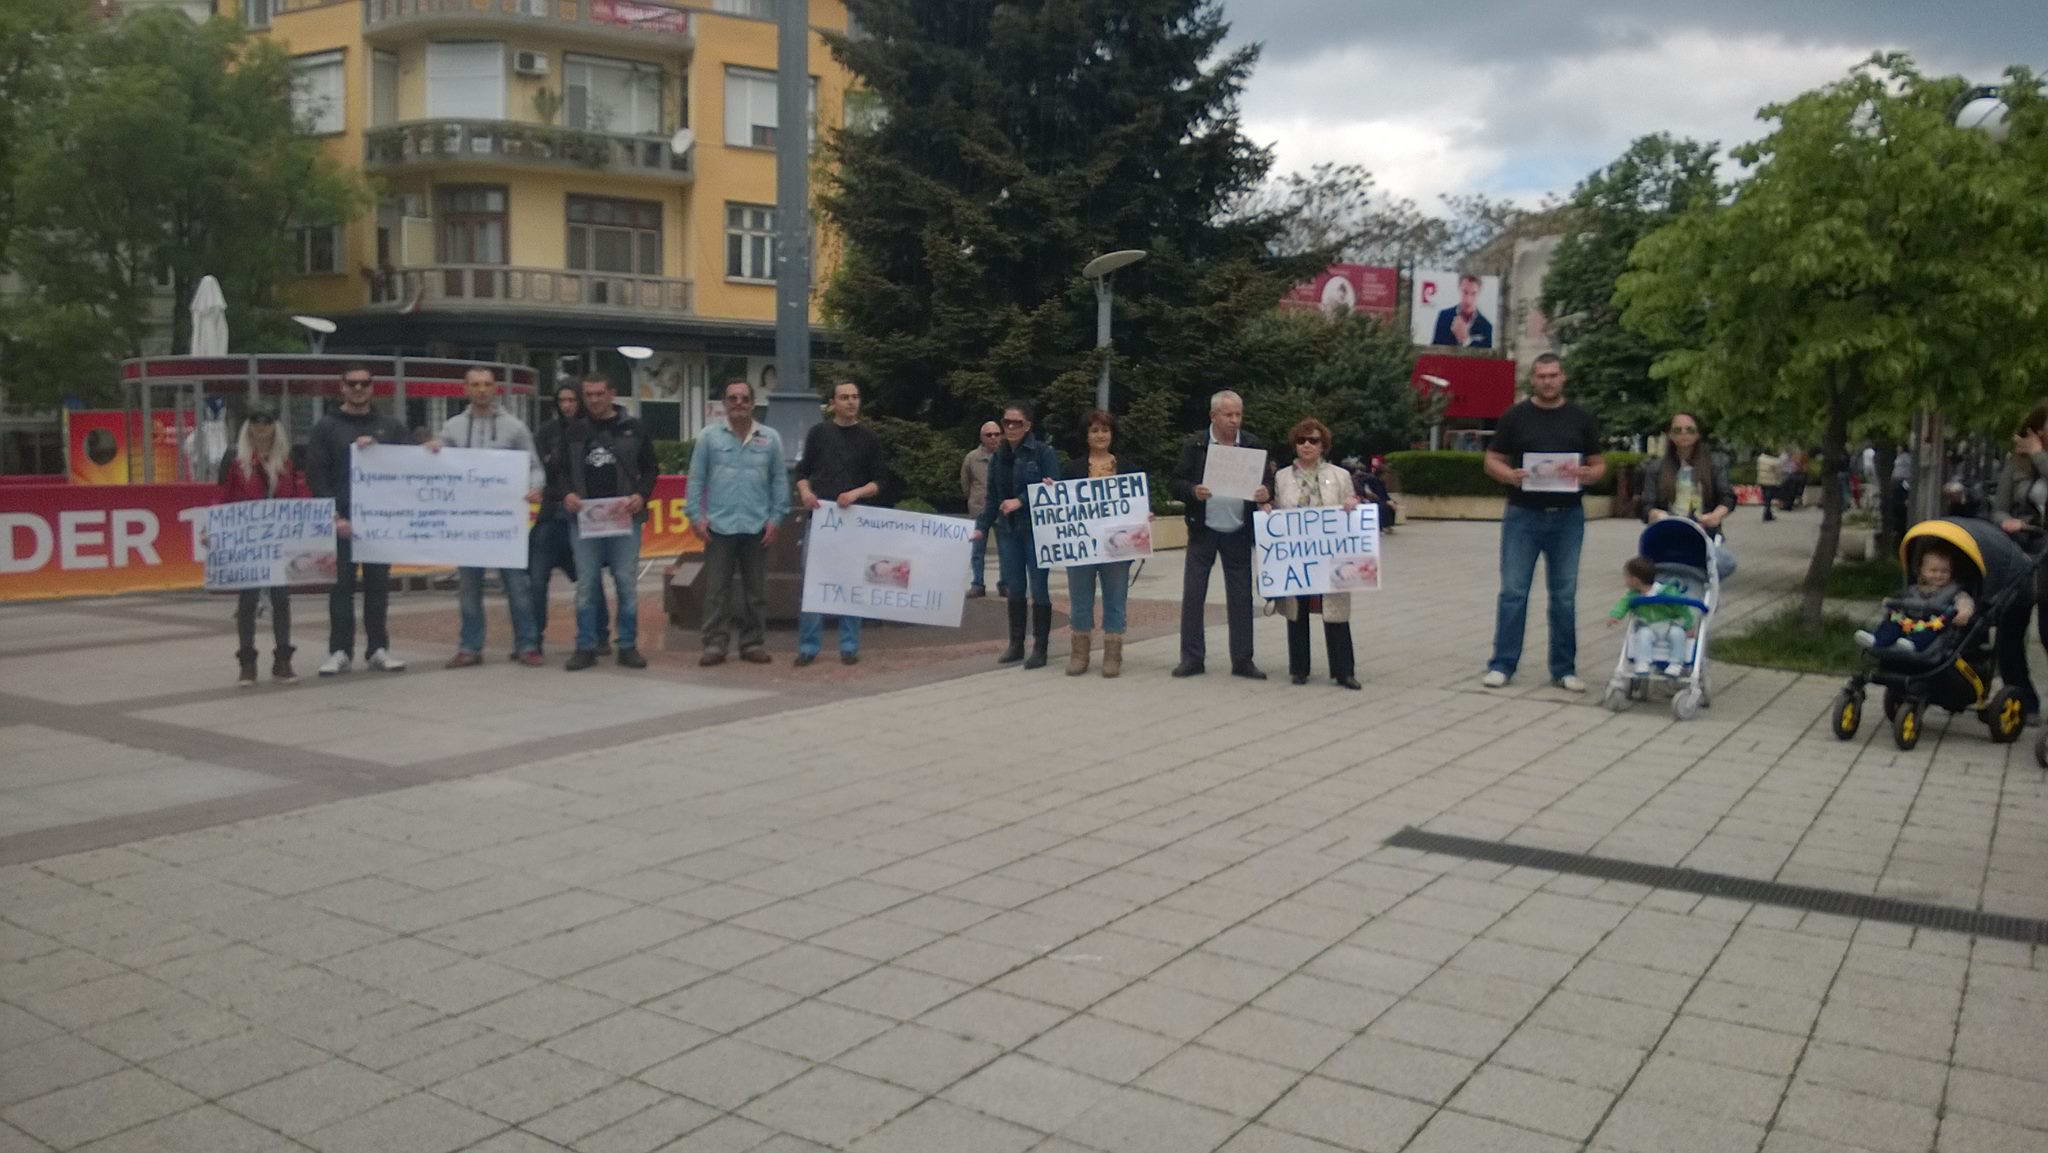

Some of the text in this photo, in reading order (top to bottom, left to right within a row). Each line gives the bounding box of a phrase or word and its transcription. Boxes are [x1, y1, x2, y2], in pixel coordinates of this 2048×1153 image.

[1032, 475, 1145, 508] ДА СПРЕМ
[856, 516, 917, 533] защитим
[1033, 499, 1130, 526] НАСИЛИЕТО
[1266, 508, 1377, 538] СПРЕТЕ
[1056, 522, 1090, 539] НАД
[1284, 562, 1319, 591] АГ
